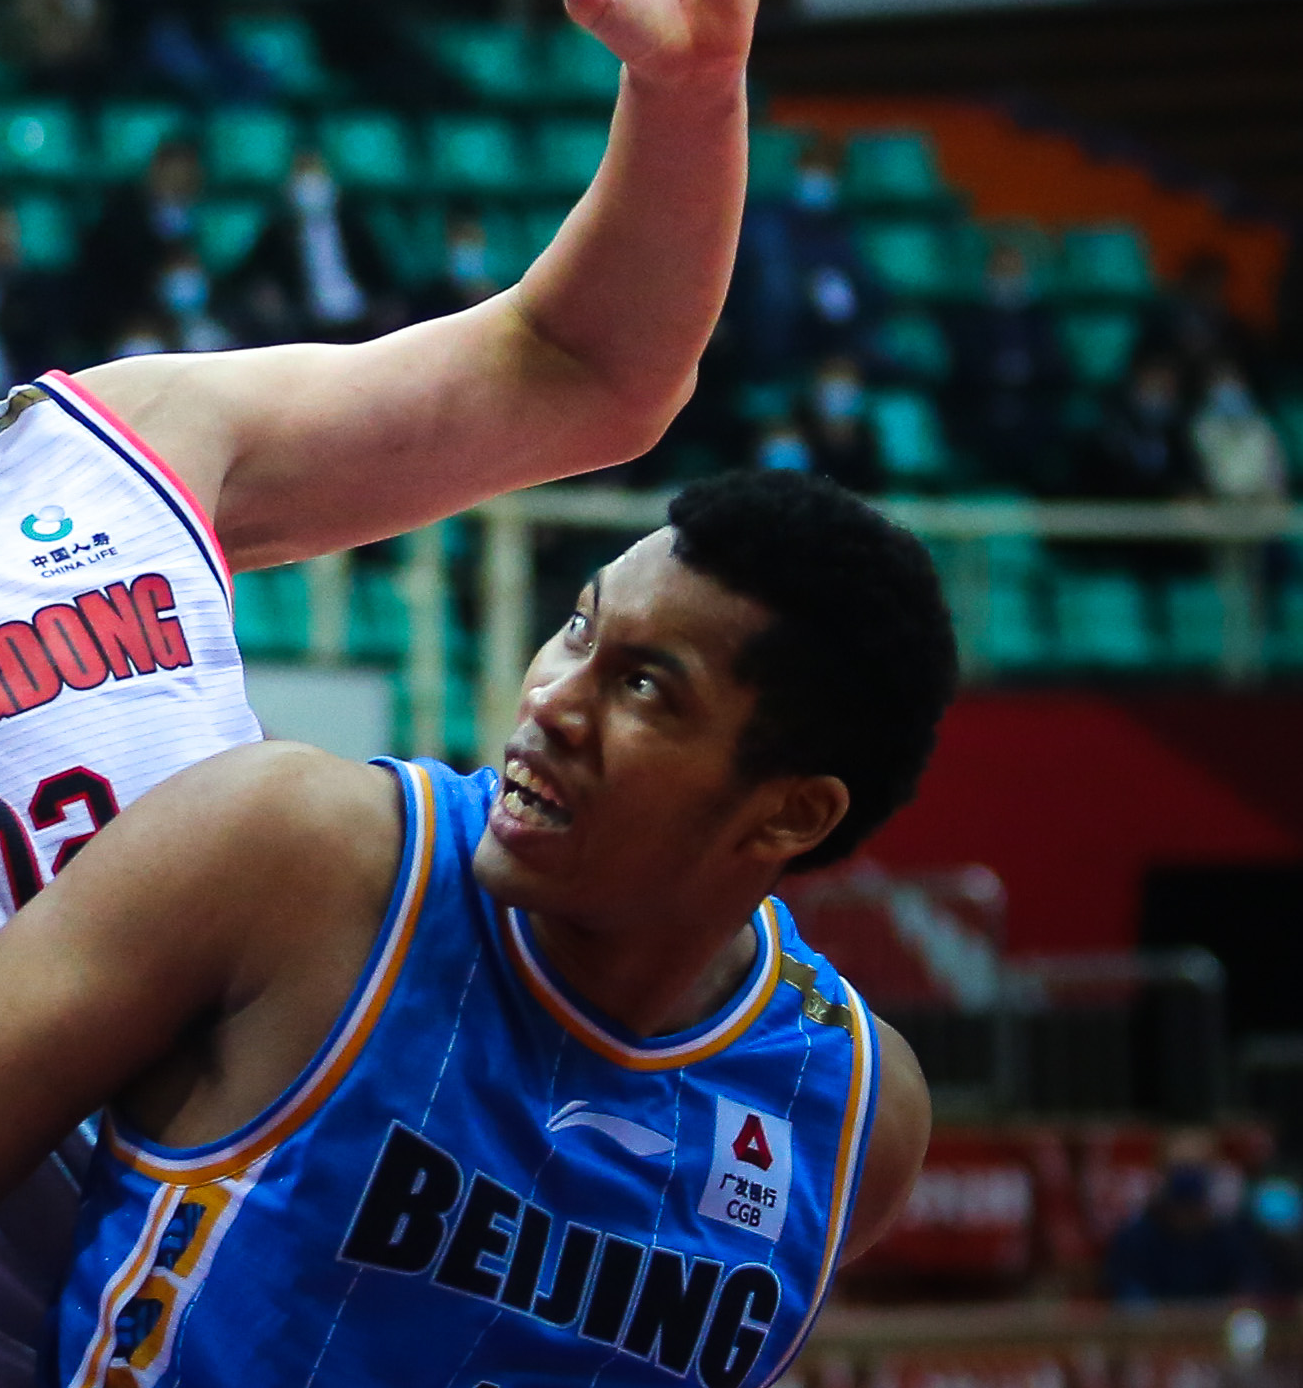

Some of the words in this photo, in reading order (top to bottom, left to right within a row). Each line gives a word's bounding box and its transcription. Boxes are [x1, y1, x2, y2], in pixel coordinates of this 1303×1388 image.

[31, 532, 110, 568] 中国人寿
[41, 561, 86, 578] CHINA
[87, 546, 118, 564] LIFE
[719, 1173, 778, 1209] 广发银行
[726, 1199, 761, 1227] CGB
[336, 1119, 782, 1388] BEIJING
